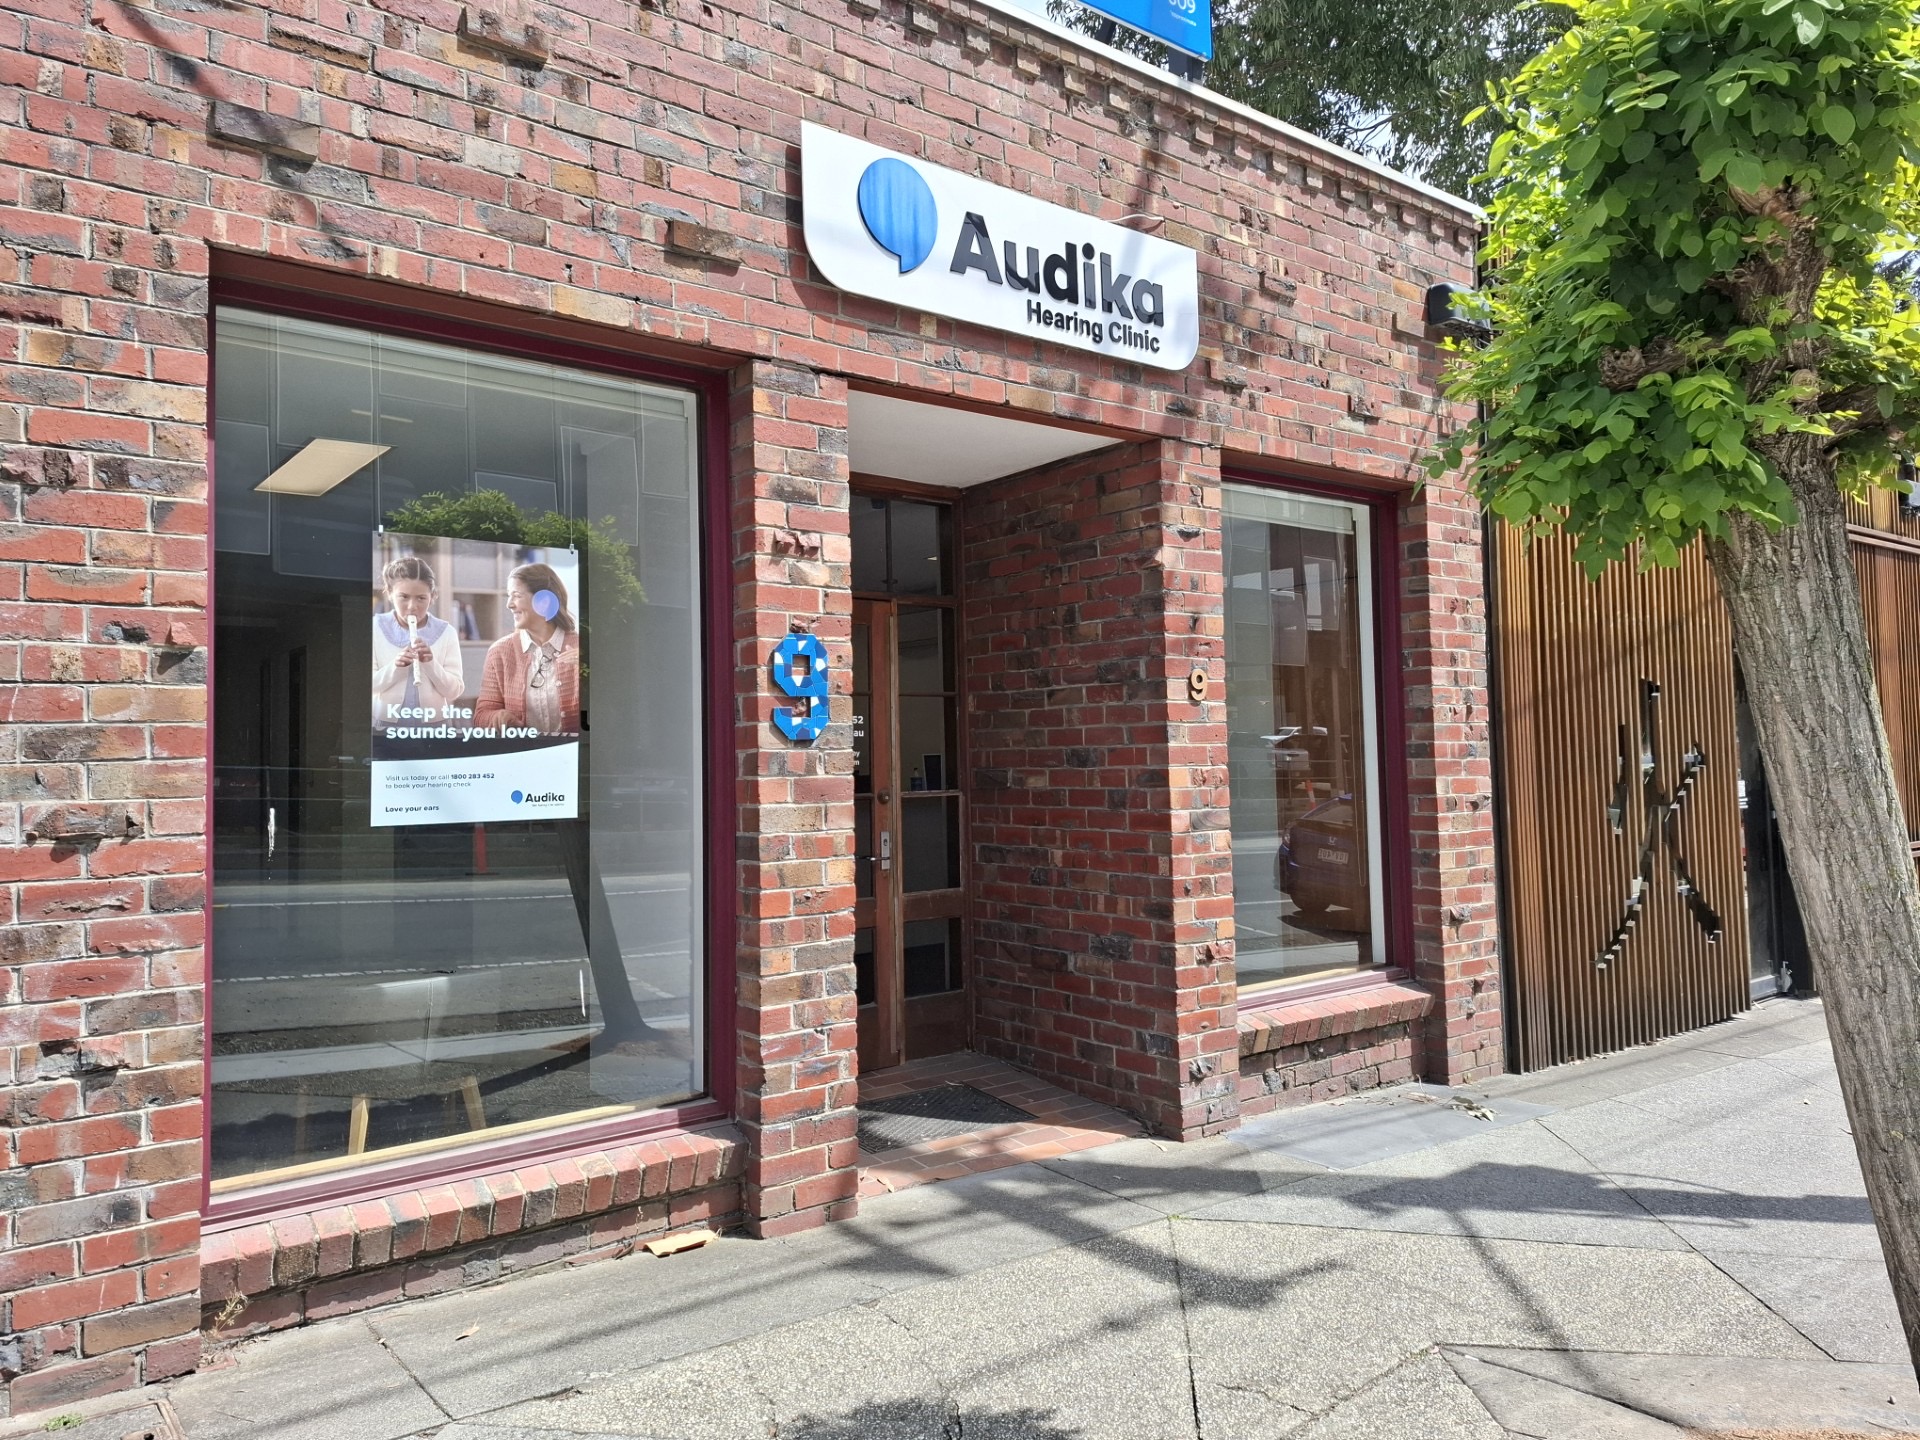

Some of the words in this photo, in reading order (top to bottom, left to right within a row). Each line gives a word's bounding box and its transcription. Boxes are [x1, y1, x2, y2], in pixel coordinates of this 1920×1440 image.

[949, 211, 1164, 328] Audika
[1027, 300, 1103, 344] Hearing
[1109, 320, 1161, 353] Clinic
[774, 633, 829, 741] 9
[1190, 669, 1208, 701] 9
[386, 704, 436, 722] Keep
[441, 704, 473, 719] the
[852, 715, 864, 724] 52
[386, 724, 457, 739] sounds
[461, 727, 496, 742] you
[501, 724, 538, 739] love
[525, 792, 565, 803] Audika
